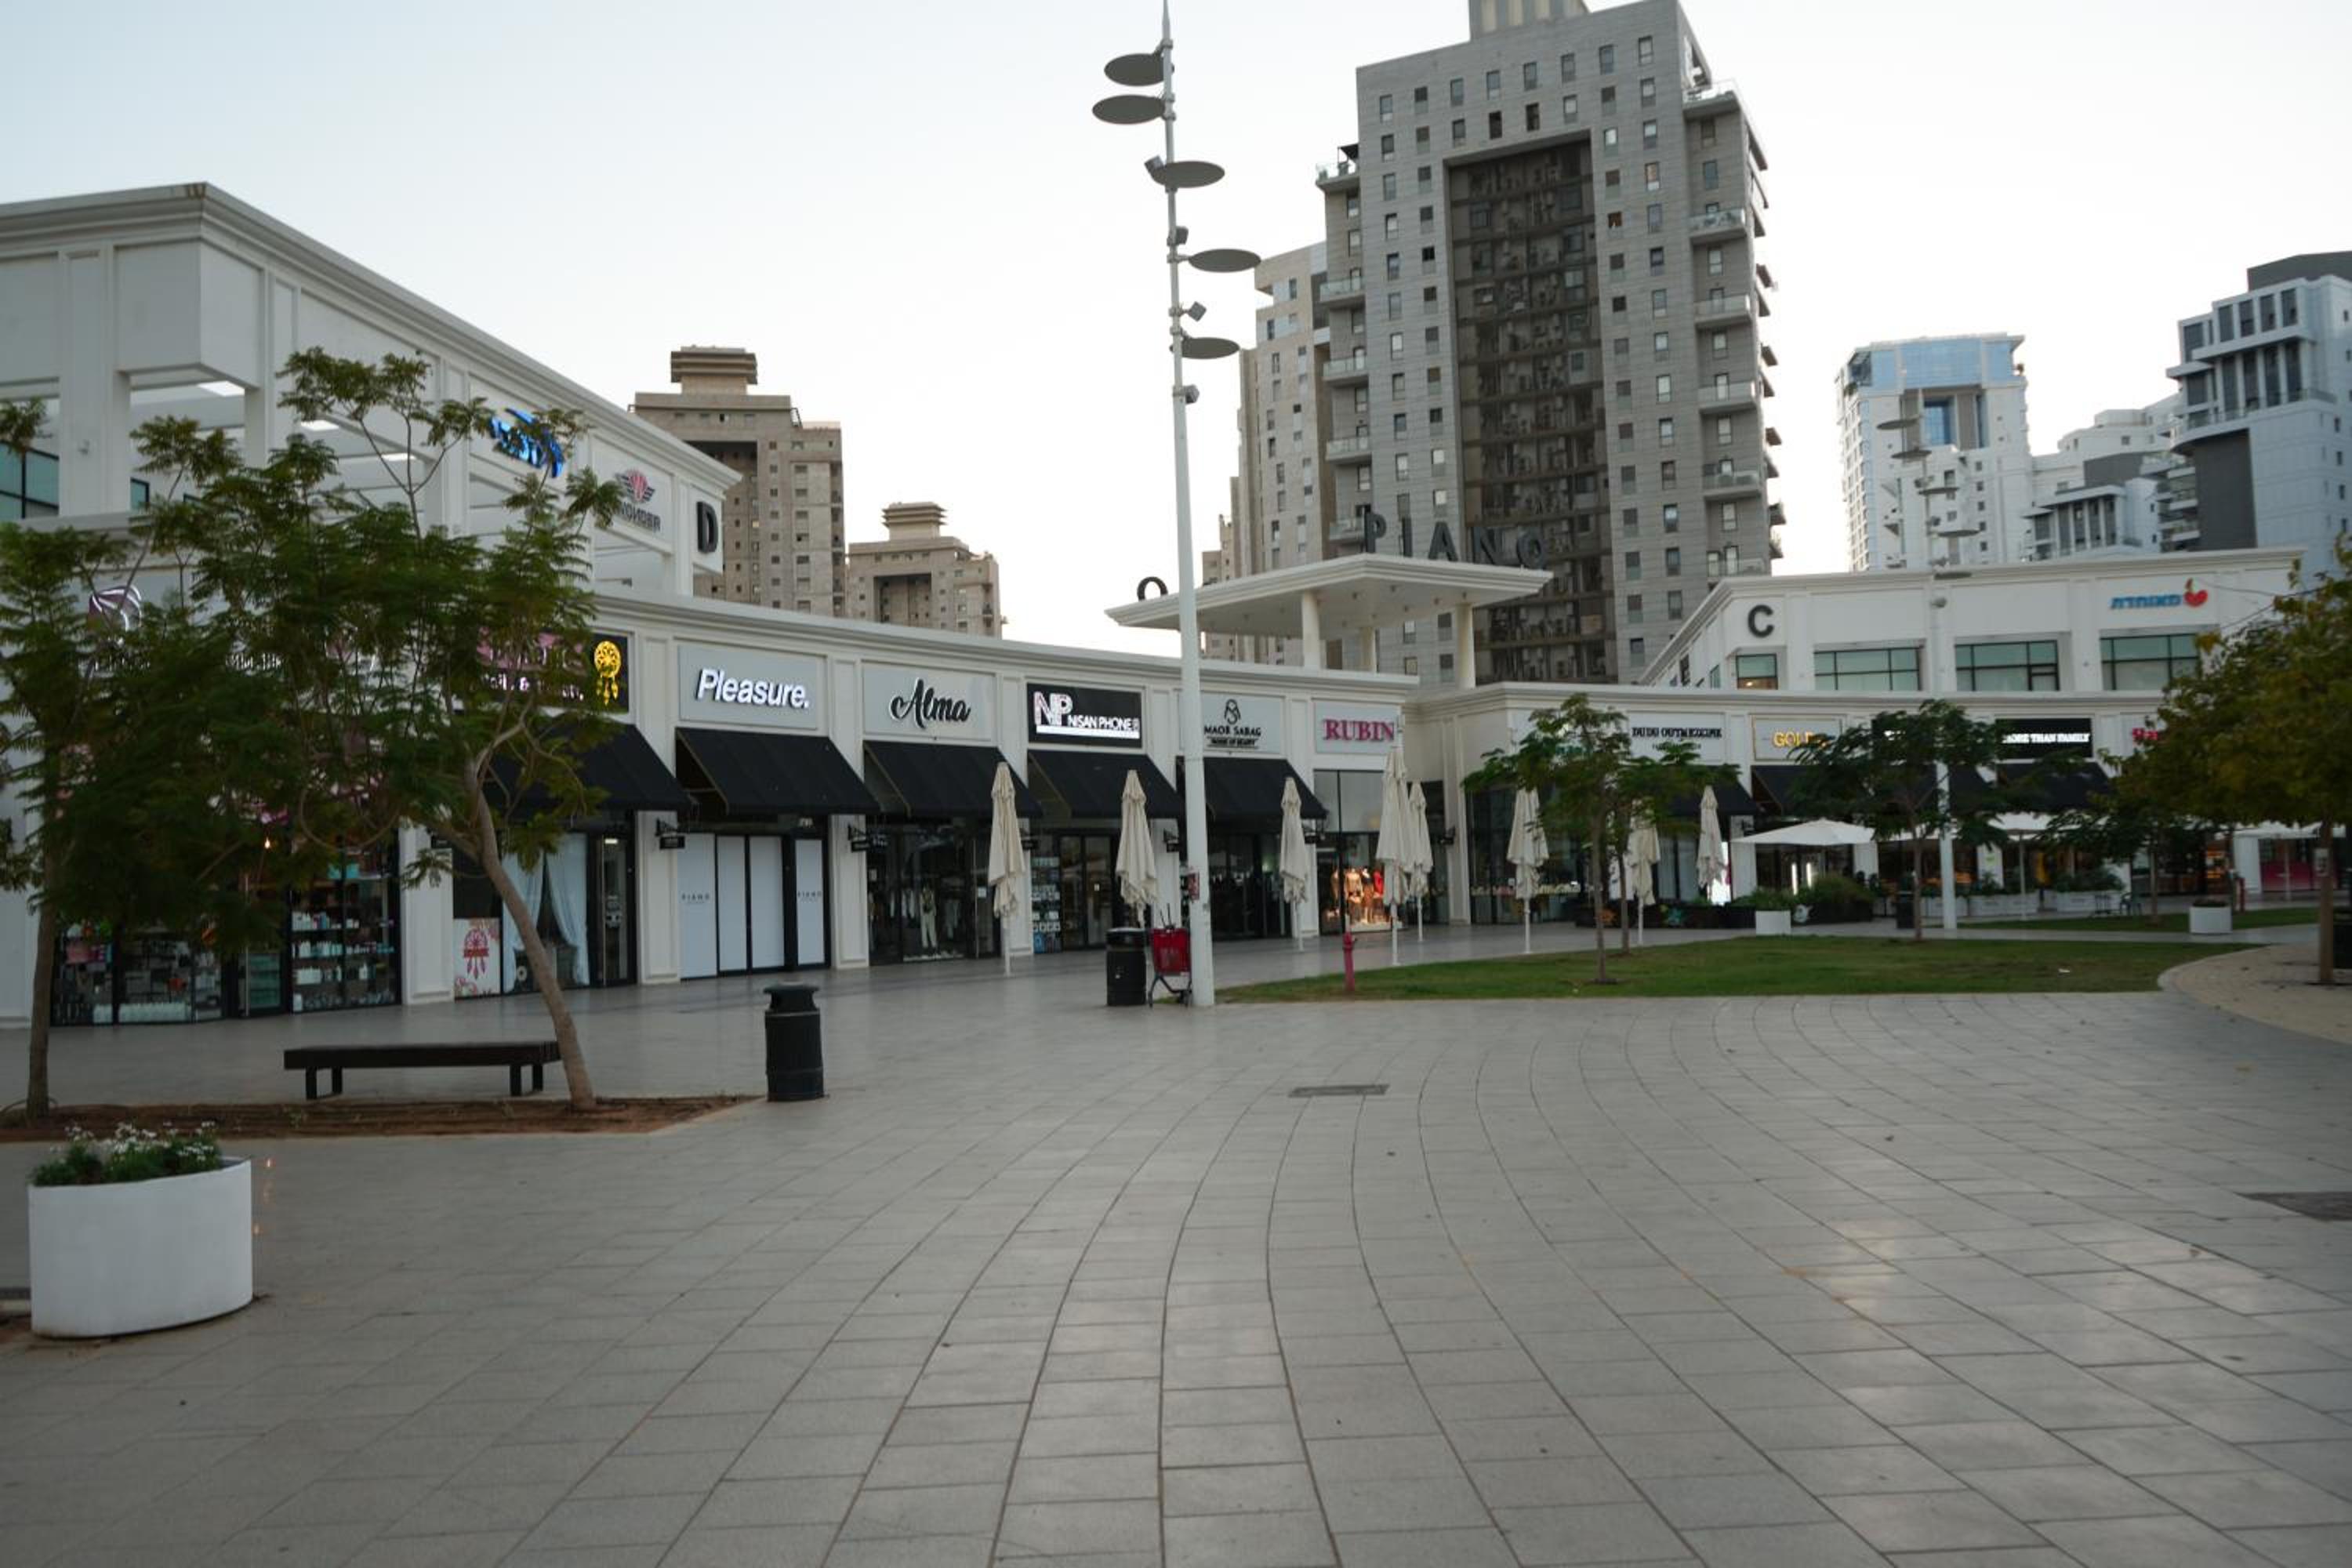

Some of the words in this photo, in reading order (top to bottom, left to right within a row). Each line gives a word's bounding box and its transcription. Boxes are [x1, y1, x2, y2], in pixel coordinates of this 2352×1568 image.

[696, 501, 719, 554] D
[1364, 511, 1549, 568] PIANO
[1748, 604, 1774, 638] C
[696, 668, 811, 709] Pleasure.
[889, 678, 971, 728] Alma
[1034, 691, 1073, 726] NP
[1067, 714, 1098, 728] NISAN
[1098, 716, 1131, 731] PHONE
[1323, 719, 1395, 741] RUBIN
[1632, 728, 1659, 737] DUDU
[2031, 733, 2056, 743] THAN
[2056, 733, 2090, 743] FAMILY
